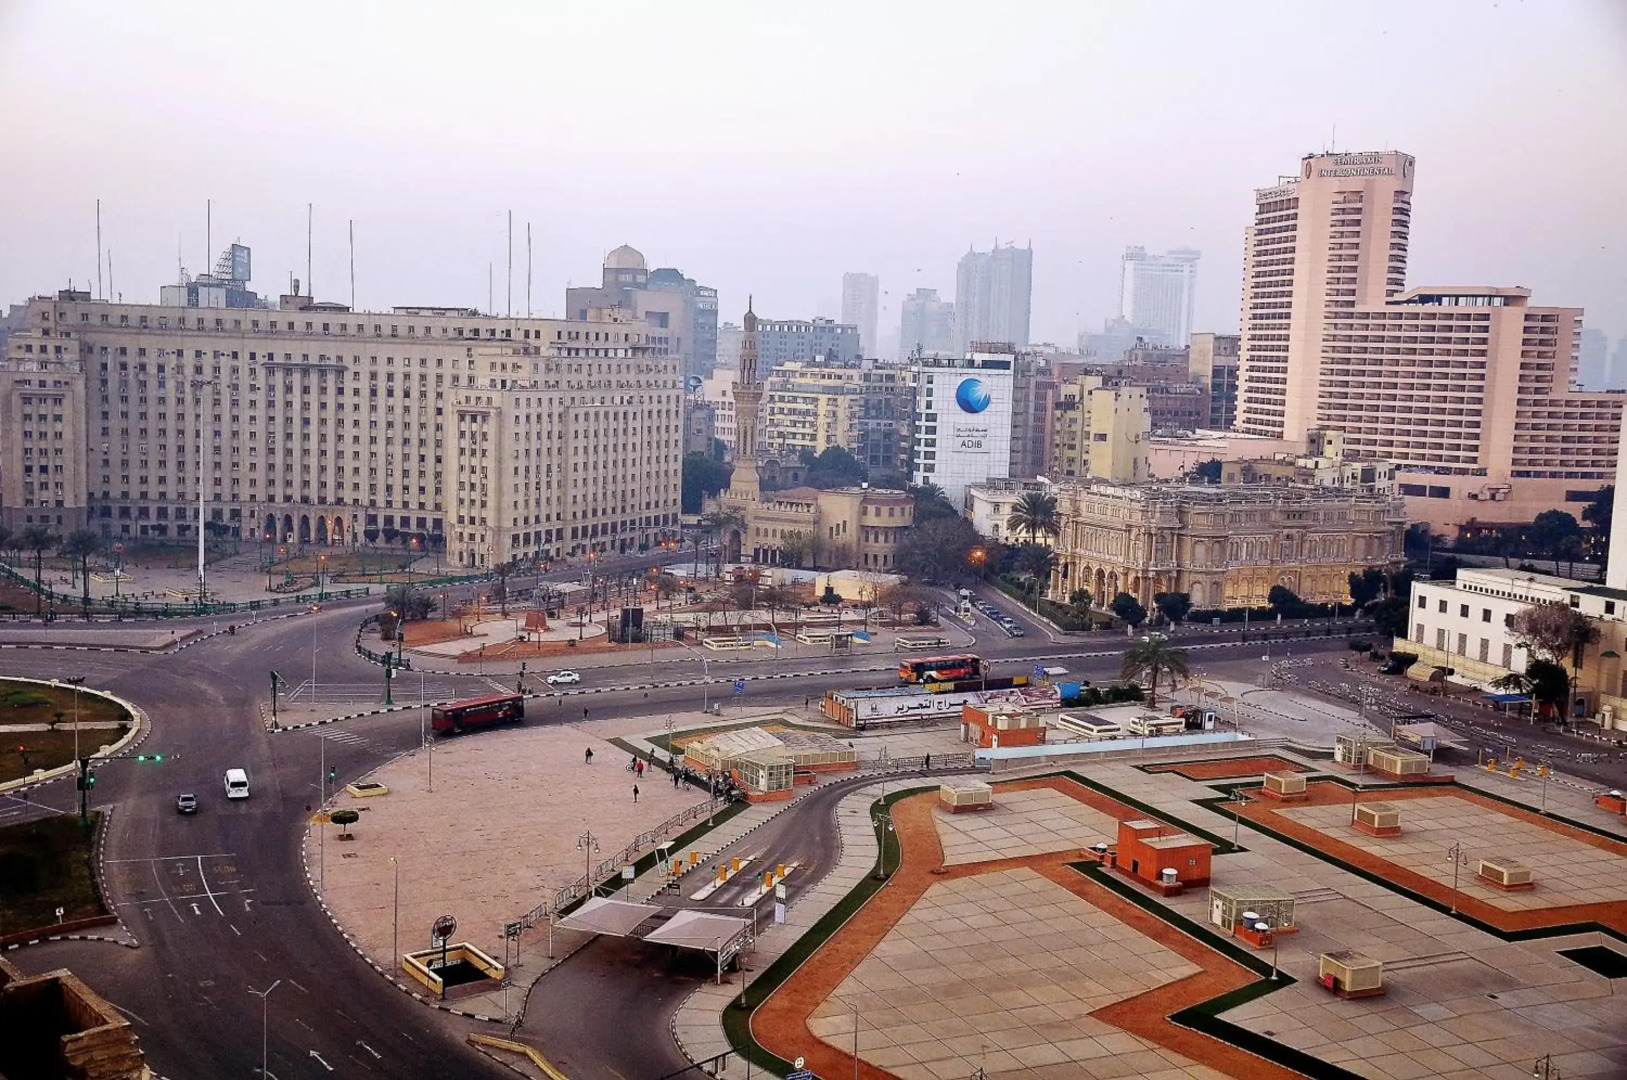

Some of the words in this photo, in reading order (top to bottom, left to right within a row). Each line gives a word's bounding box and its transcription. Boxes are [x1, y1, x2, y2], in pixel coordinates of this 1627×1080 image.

[1333, 156, 1383, 166] SEMIRAMIS
[1318, 167, 1395, 178] INTERCONTINENTAL
[960, 439, 983, 449] ADIB
[894, 699, 935, 714] التحرير
